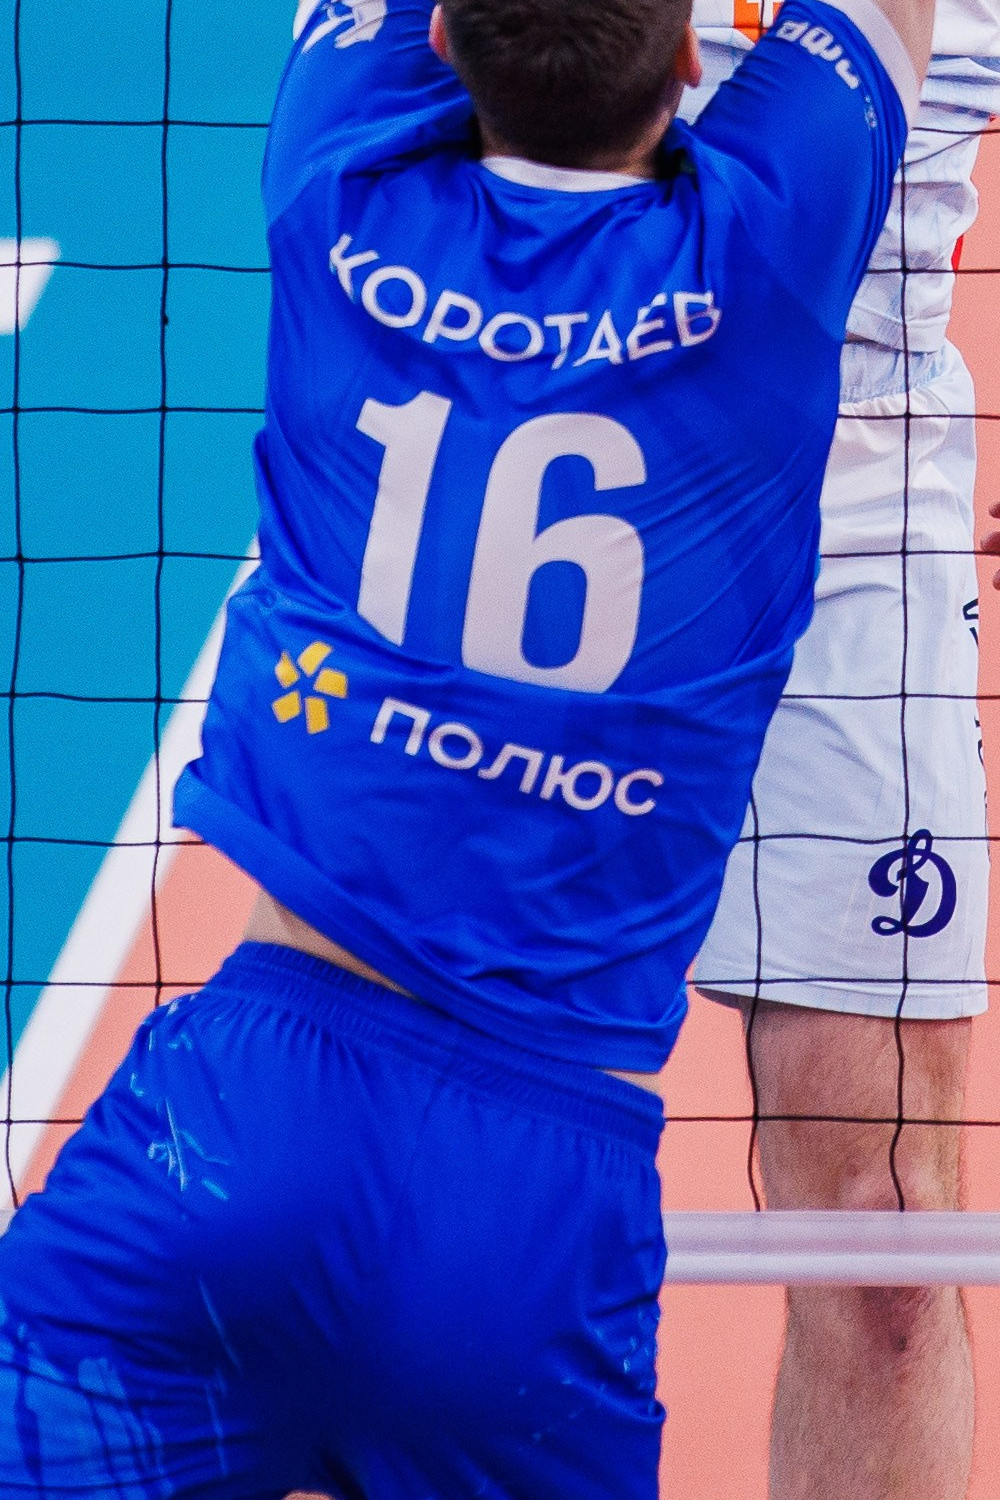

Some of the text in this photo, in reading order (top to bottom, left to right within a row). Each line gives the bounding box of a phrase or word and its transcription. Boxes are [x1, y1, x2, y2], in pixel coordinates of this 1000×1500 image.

[328, 234, 722, 370] КОРОТАЕВ
[356, 389, 648, 694] 16
[370, 697, 664, 815] ПОЛЮС
